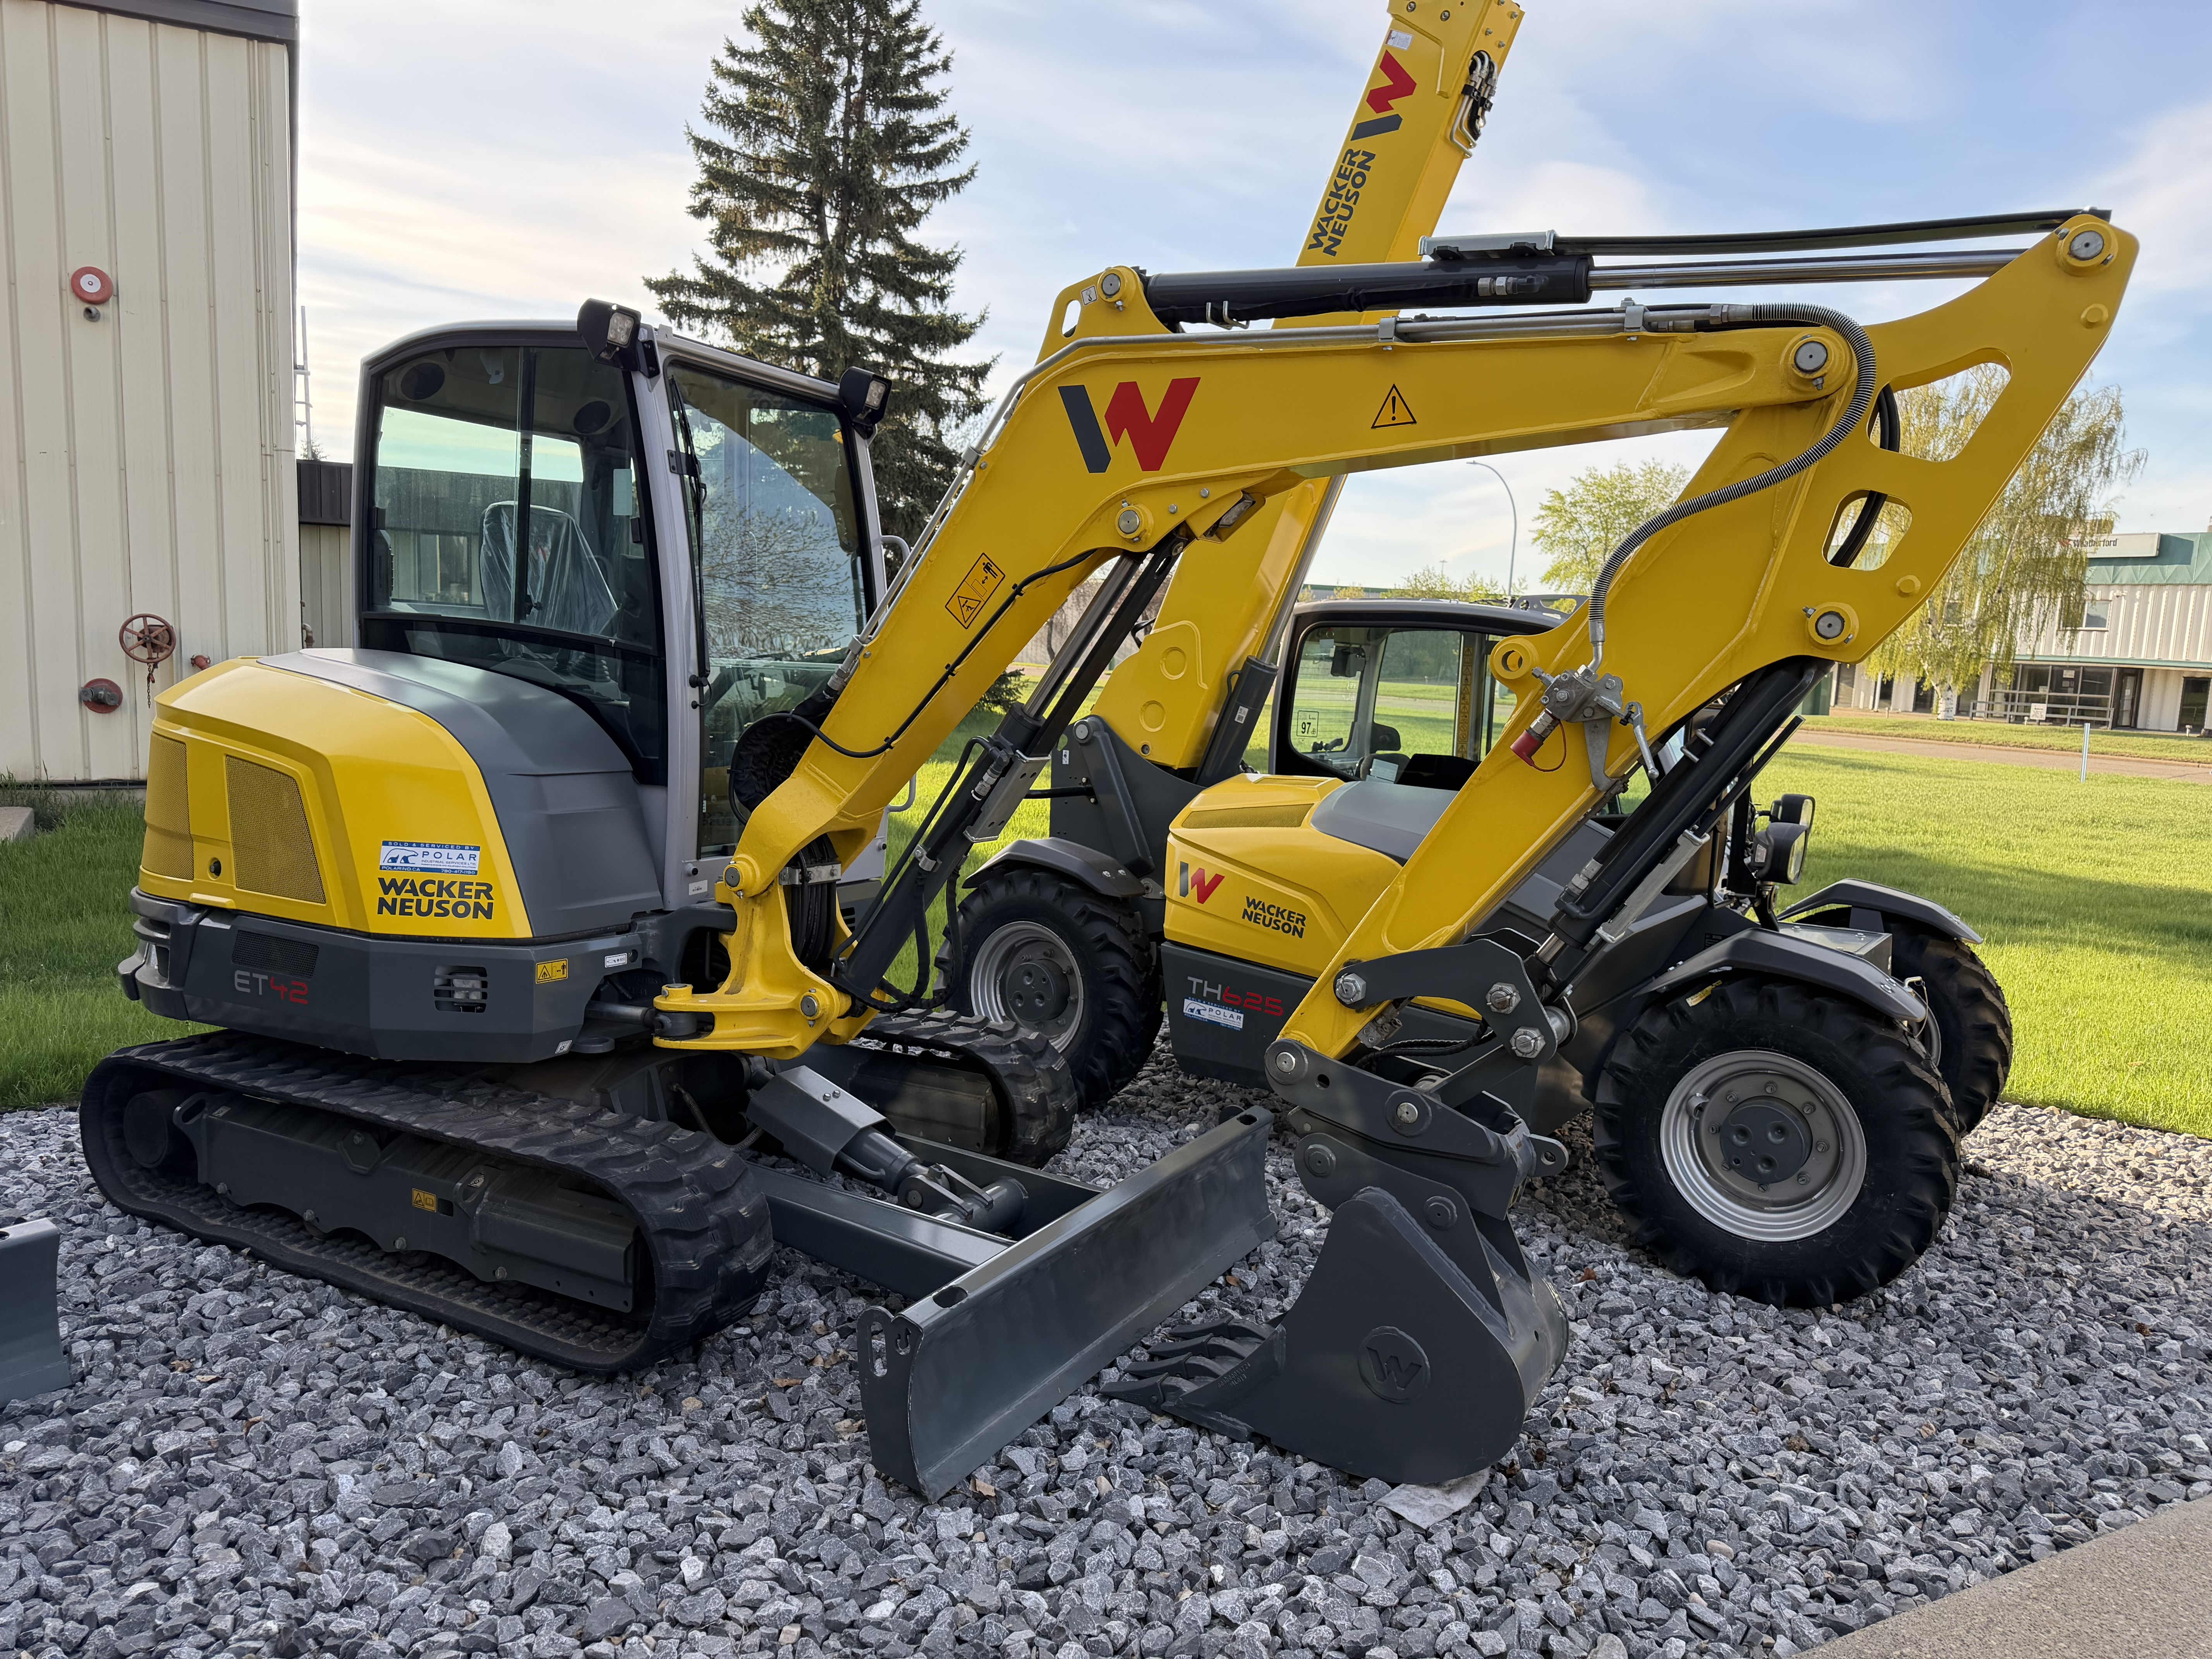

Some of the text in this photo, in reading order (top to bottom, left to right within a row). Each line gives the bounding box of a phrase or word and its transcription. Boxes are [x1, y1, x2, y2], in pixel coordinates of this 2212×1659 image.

[1308, 148, 1361, 250] WACKER
[1322, 150, 1376, 257] NEUSON
[2073, 538, 2117, 547] Wathrford
[1301, 722, 1311, 734] 97
[422, 851, 477, 861] POLAR
[378, 877, 494, 900] WACKER
[377, 897, 493, 920] NEUSON
[1246, 896, 1306, 927] WACKER
[1242, 908, 1304, 939] NEUSON
[234, 970, 308, 1004] ET42
[1187, 976, 1284, 1017] TH625
[1209, 1008, 1242, 1021] POLAR
